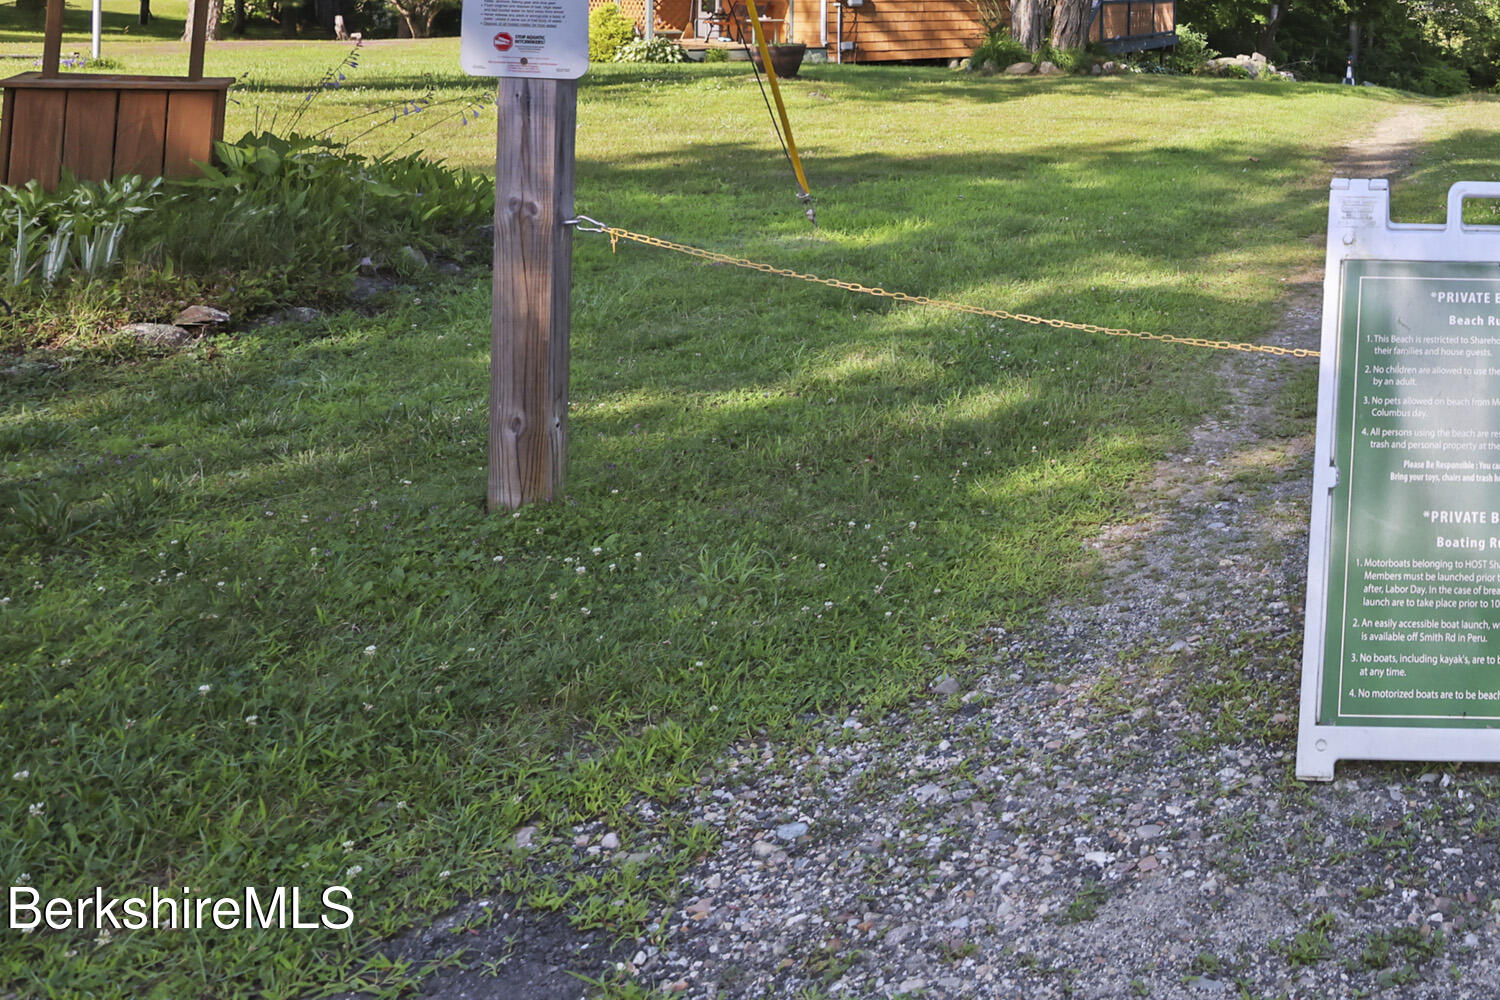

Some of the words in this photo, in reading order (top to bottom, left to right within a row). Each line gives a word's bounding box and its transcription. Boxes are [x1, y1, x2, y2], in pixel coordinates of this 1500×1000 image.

[1448, 314, 1484, 326] Beach
[1366, 334, 1373, 343] 1.
[1373, 334, 1389, 343] This
[1390, 334, 1414, 343] Beach
[1422, 334, 1459, 344] restricted
[1459, 336, 1469, 344] to
[1364, 365, 1372, 373] 2.
[1372, 365, 1384, 374] No
[1385, 365, 1417, 374] children
[1431, 366, 1462, 375] allowed
[1488, 367, 1500, 376] the
[1360, 427, 1369, 436] 4.
[1369, 427, 1380, 436] All
[1381, 430, 1412, 438] persons
[1413, 428, 1435, 439] using
[1436, 428, 1450, 437] the
[1451, 429, 1475, 438] beach
[1369, 439, 1390, 448] trash
[1390, 440, 1406, 449] and
[1407, 440, 1441, 451] personal
[1442, 441, 1477, 452] property
[1478, 442, 1486, 450] at
[1487, 441, 1500, 450] the
[1436, 536, 1485, 551] Boating
[1355, 557, 1363, 567] 1.
[1363, 557, 1411, 568] Motorboats
[1411, 558, 1453, 570] belonging
[1454, 560, 1464, 569] to
[1464, 559, 1487, 569] HOST
[1363, 570, 1402, 580] Members
[1402, 572, 1424, 581] must
[1425, 571, 1436, 581] be
[1437, 572, 1474, 582] launched
[1475, 572, 1496, 584] prior
[1362, 583, 1384, 594] after,
[1385, 584, 1408, 594] Labor
[1409, 584, 1427, 596] Day.
[1428, 584, 1437, 594] In
[1438, 584, 1452, 594] the
[1472, 585, 1482, 595] of
[1362, 596, 1390, 606] launch
[1405, 598, 1415, 607] to
[1416, 597, 1434, 607] take
[1435, 598, 1457, 610] place
[1458, 598, 1478, 610] prior
[1479, 600, 1489, 608] to
[1490, 598, 1500, 609] 10
[1352, 617, 1360, 627] 2.
[1360, 617, 1373, 627] An
[1374, 618, 1397, 630] easily
[1398, 618, 1439, 629] accessible
[1440, 619, 1459, 629] boat
[1460, 619, 1490, 631] launch,
[1368, 631, 1405, 641] available
[1406, 632, 1418, 642] off
[1419, 632, 1443, 642] Smith
[1444, 632, 1456, 642] Rd
[1457, 632, 1466, 642] in
[1466, 633, 1488, 643] Peru.
[1350, 652, 1358, 662] 3.
[1359, 652, 1372, 663] No
[1372, 652, 1398, 664] boats,
[1399, 653, 1438, 666] including
[1439, 654, 1470, 667] kayak's,
[1486, 656, 1496, 665] to
[1359, 667, 1368, 676] at
[1368, 669, 1384, 678] any
[1385, 666, 1407, 676] time.
[1348, 687, 1357, 698] 4.
[1357, 687, 1370, 698] No
[1371, 688, 1414, 699] motorized
[1415, 688, 1439, 699] boats
[1454, 691, 1464, 700] to
[1465, 689, 1476, 700] be
